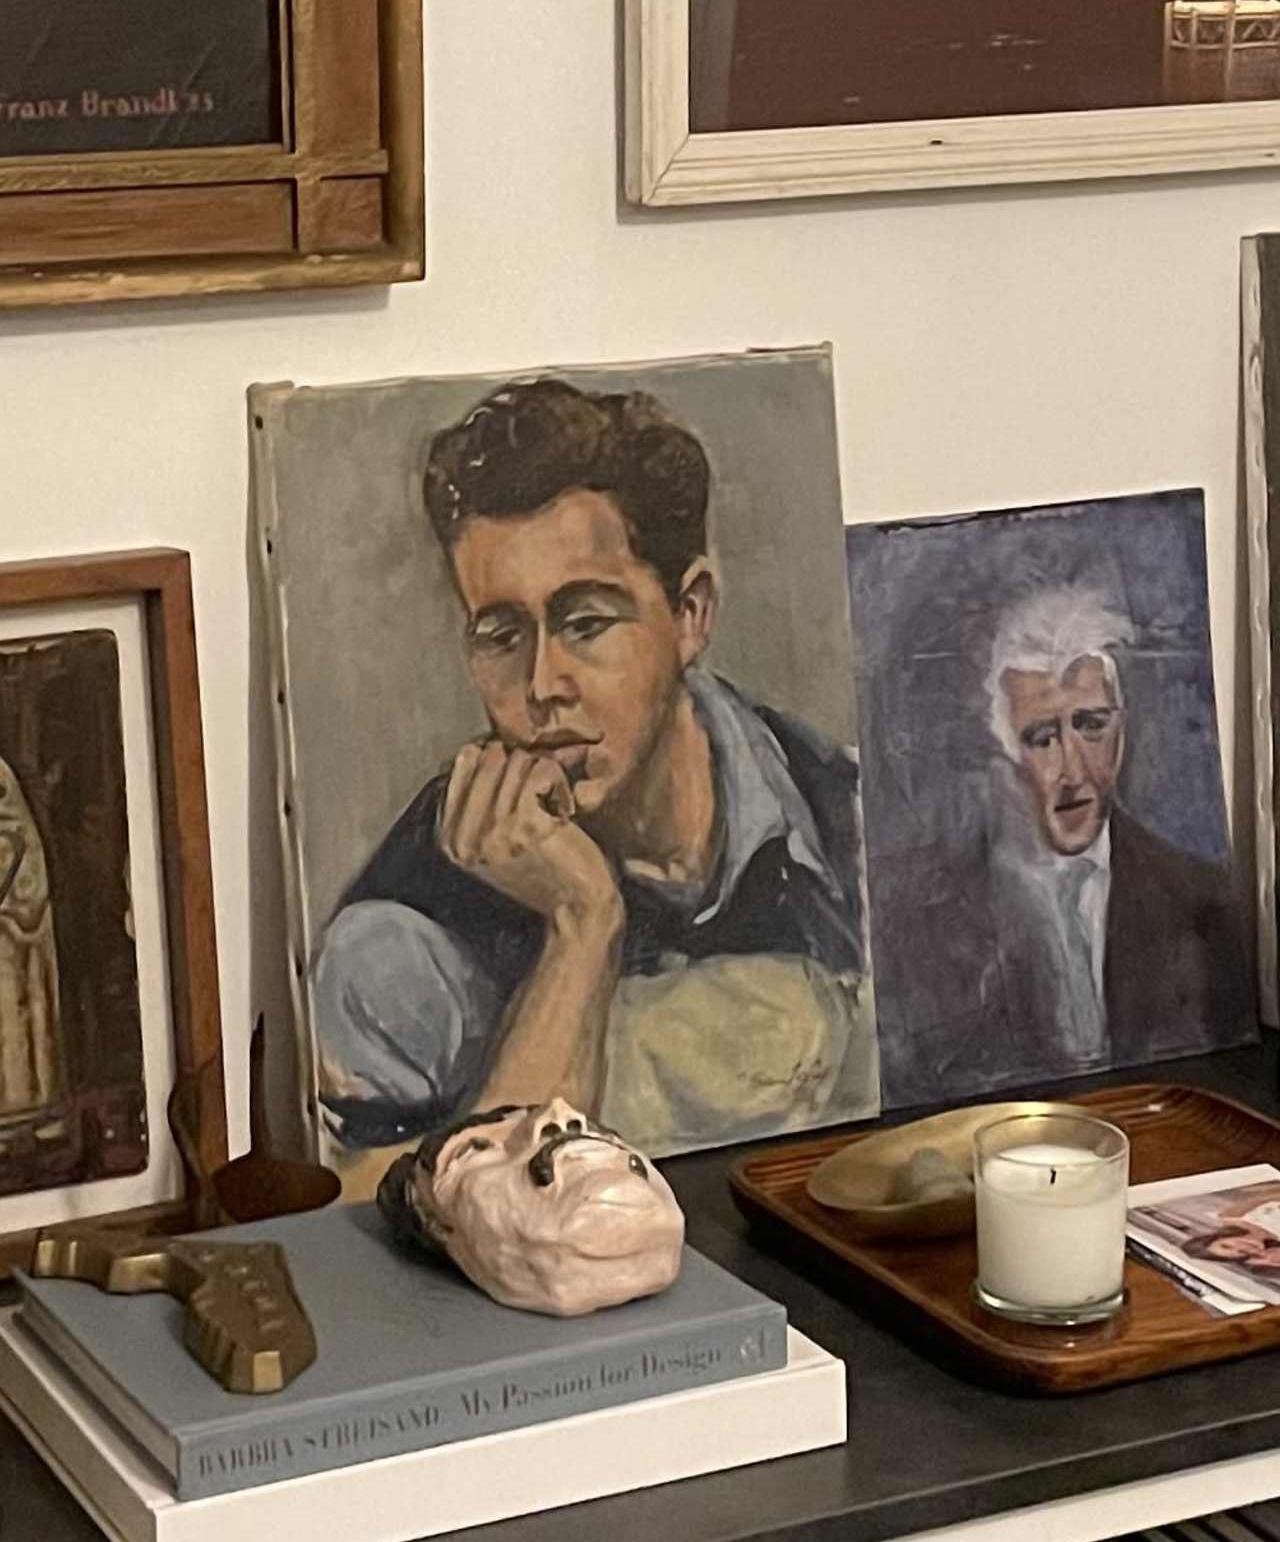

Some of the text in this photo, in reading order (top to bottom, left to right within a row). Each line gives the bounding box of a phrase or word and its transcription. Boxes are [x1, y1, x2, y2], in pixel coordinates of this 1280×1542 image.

[198, 1439, 296, 1478] BARBRA
[302, 1404, 441, 1452] STREISAND
[498, 1374, 593, 1411] Passion
[640, 1347, 723, 1386] Design
